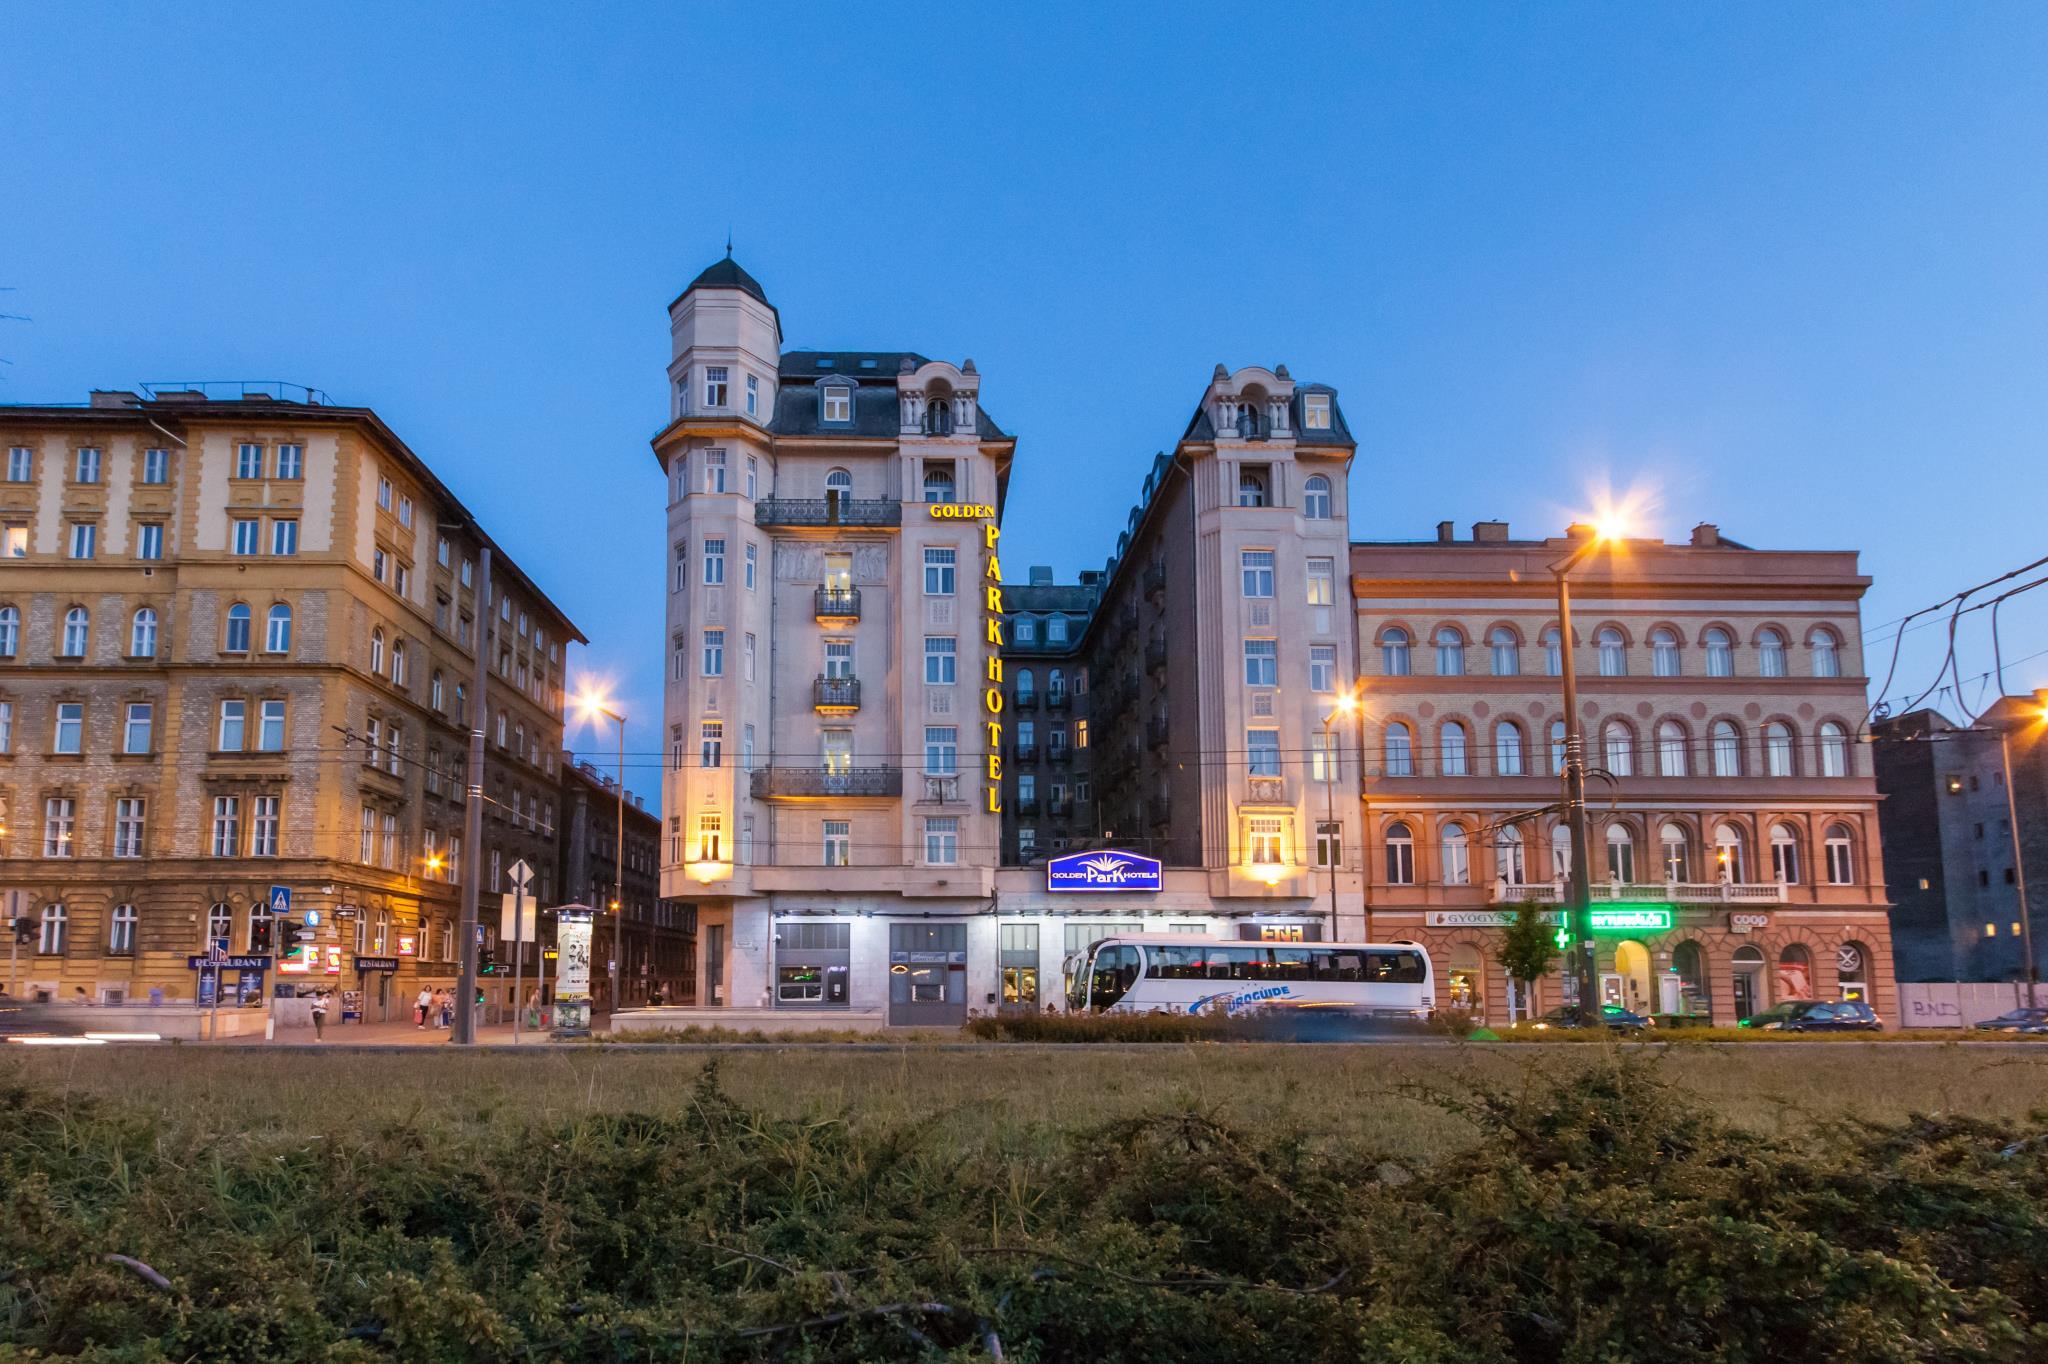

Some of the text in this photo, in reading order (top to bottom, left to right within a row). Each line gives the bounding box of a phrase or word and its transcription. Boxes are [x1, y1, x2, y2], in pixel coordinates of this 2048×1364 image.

[930, 504, 995, 518] GOLDEN
[985, 523, 1003, 813] PARK HOTEL
